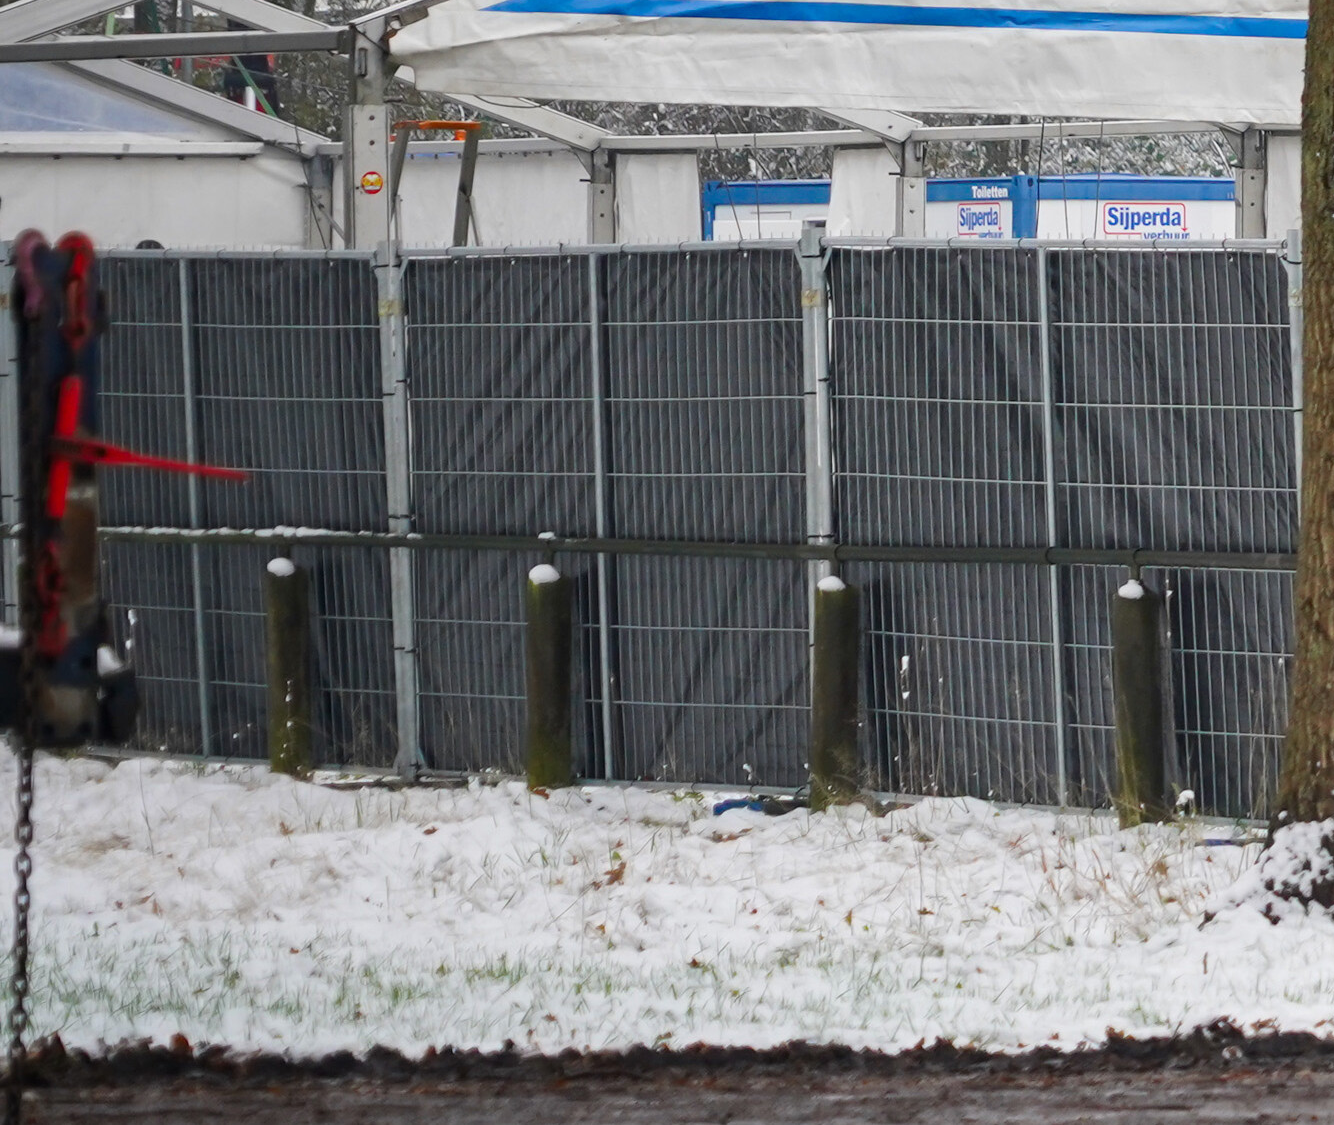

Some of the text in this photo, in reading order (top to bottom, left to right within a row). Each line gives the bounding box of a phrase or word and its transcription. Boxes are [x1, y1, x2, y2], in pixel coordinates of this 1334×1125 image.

[971, 185, 1009, 199] Toiletten
[959, 207, 999, 231] Sijperda
[1107, 206, 1182, 230] Sijperda
